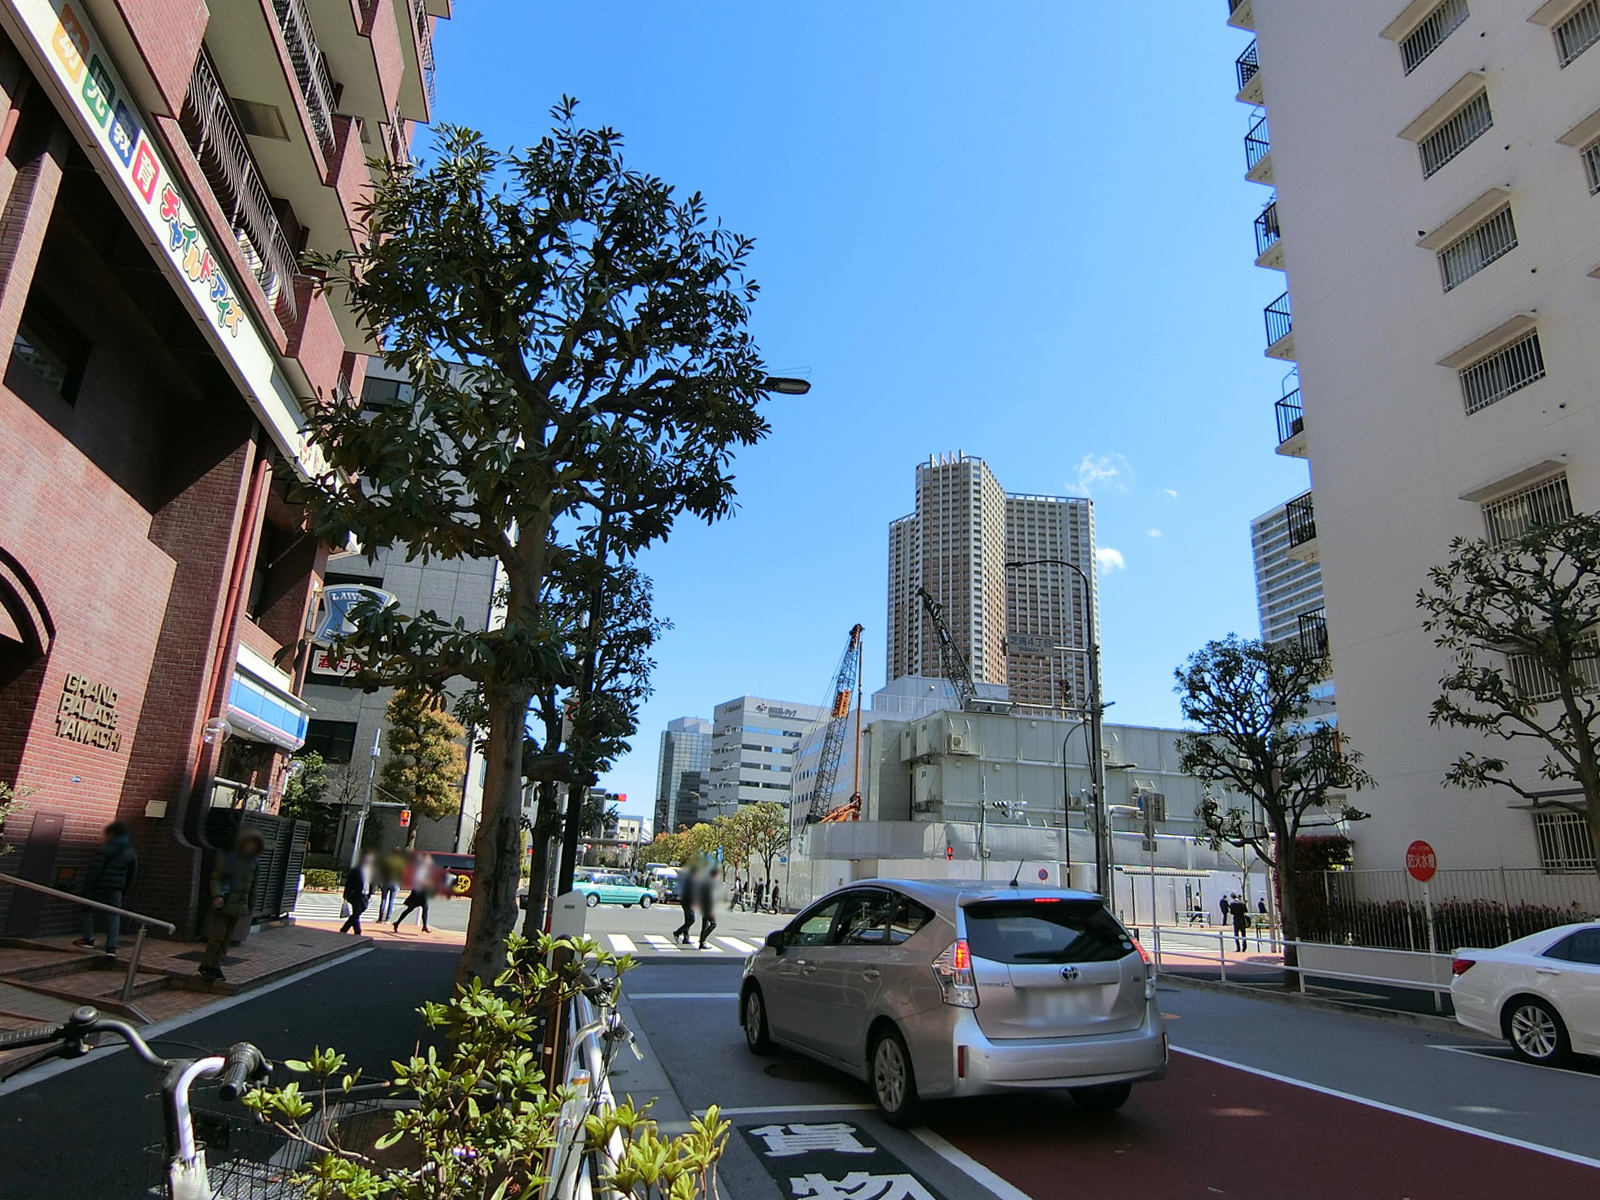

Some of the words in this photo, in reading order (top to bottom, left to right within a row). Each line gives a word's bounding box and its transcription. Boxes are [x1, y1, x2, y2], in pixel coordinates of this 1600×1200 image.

[59, 21, 156, 194] 幼児教育
[331, 591, 372, 602] LAWS
[64, 672, 119, 709] GRAND
[58, 693, 119, 730] PALACE
[55, 714, 123, 752] TAMACHI
